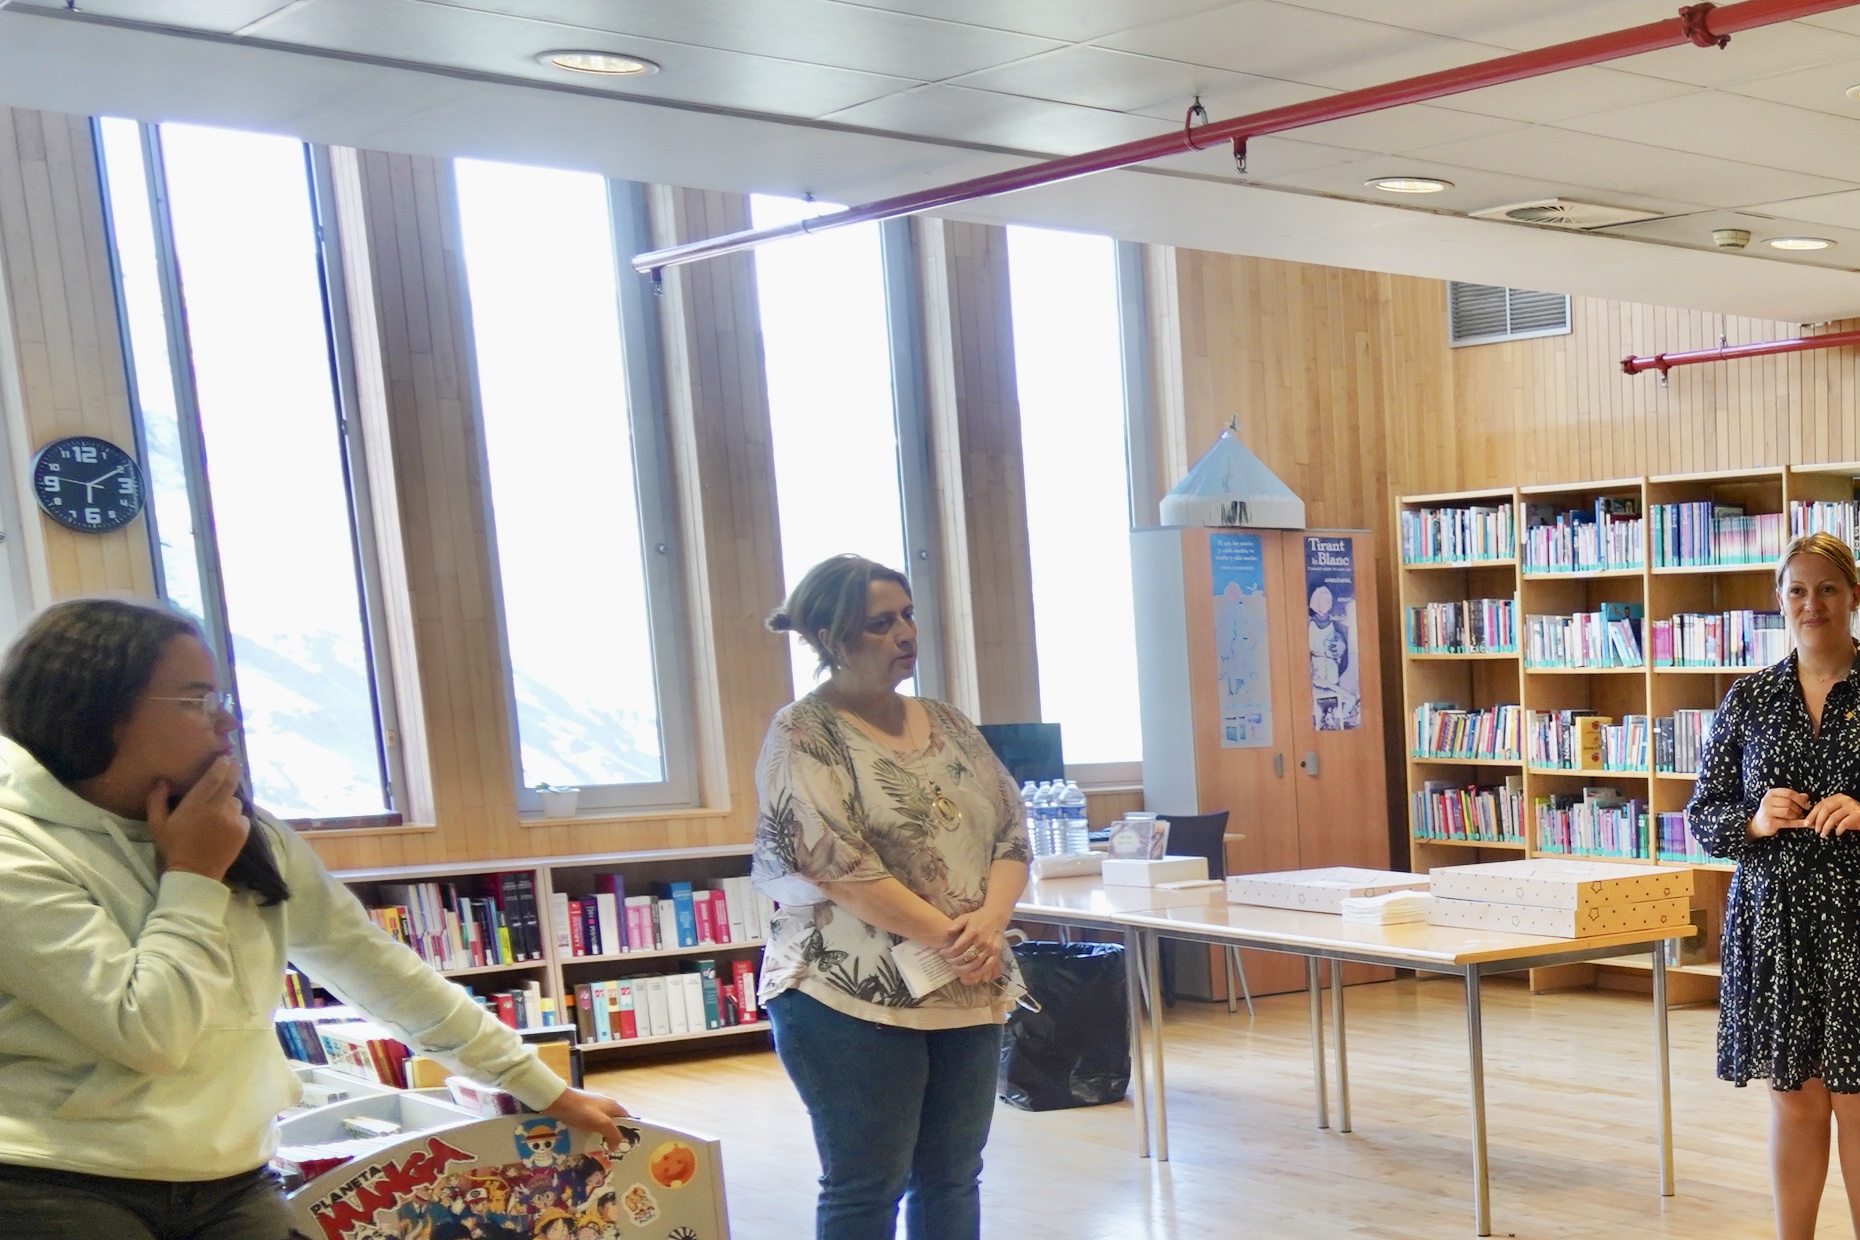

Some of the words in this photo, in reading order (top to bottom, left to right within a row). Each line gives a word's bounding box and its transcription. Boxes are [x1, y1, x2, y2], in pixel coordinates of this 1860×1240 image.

[60, 451, 70, 459] 11
[72, 446, 98, 464] 12
[48, 463, 60, 472] 10
[43, 476, 61, 492] 9
[117, 477, 134, 494] 3
[53, 497, 62, 505] 8
[120, 498, 128, 506] 4
[68, 510, 77, 518] 7
[85, 507, 101, 524] 6
[108, 510, 116, 519] 5
[1308, 537, 1345, 552] Tirant
[1318, 552, 1350, 566] Blanc
[309, 1165, 382, 1216] PLANETA
